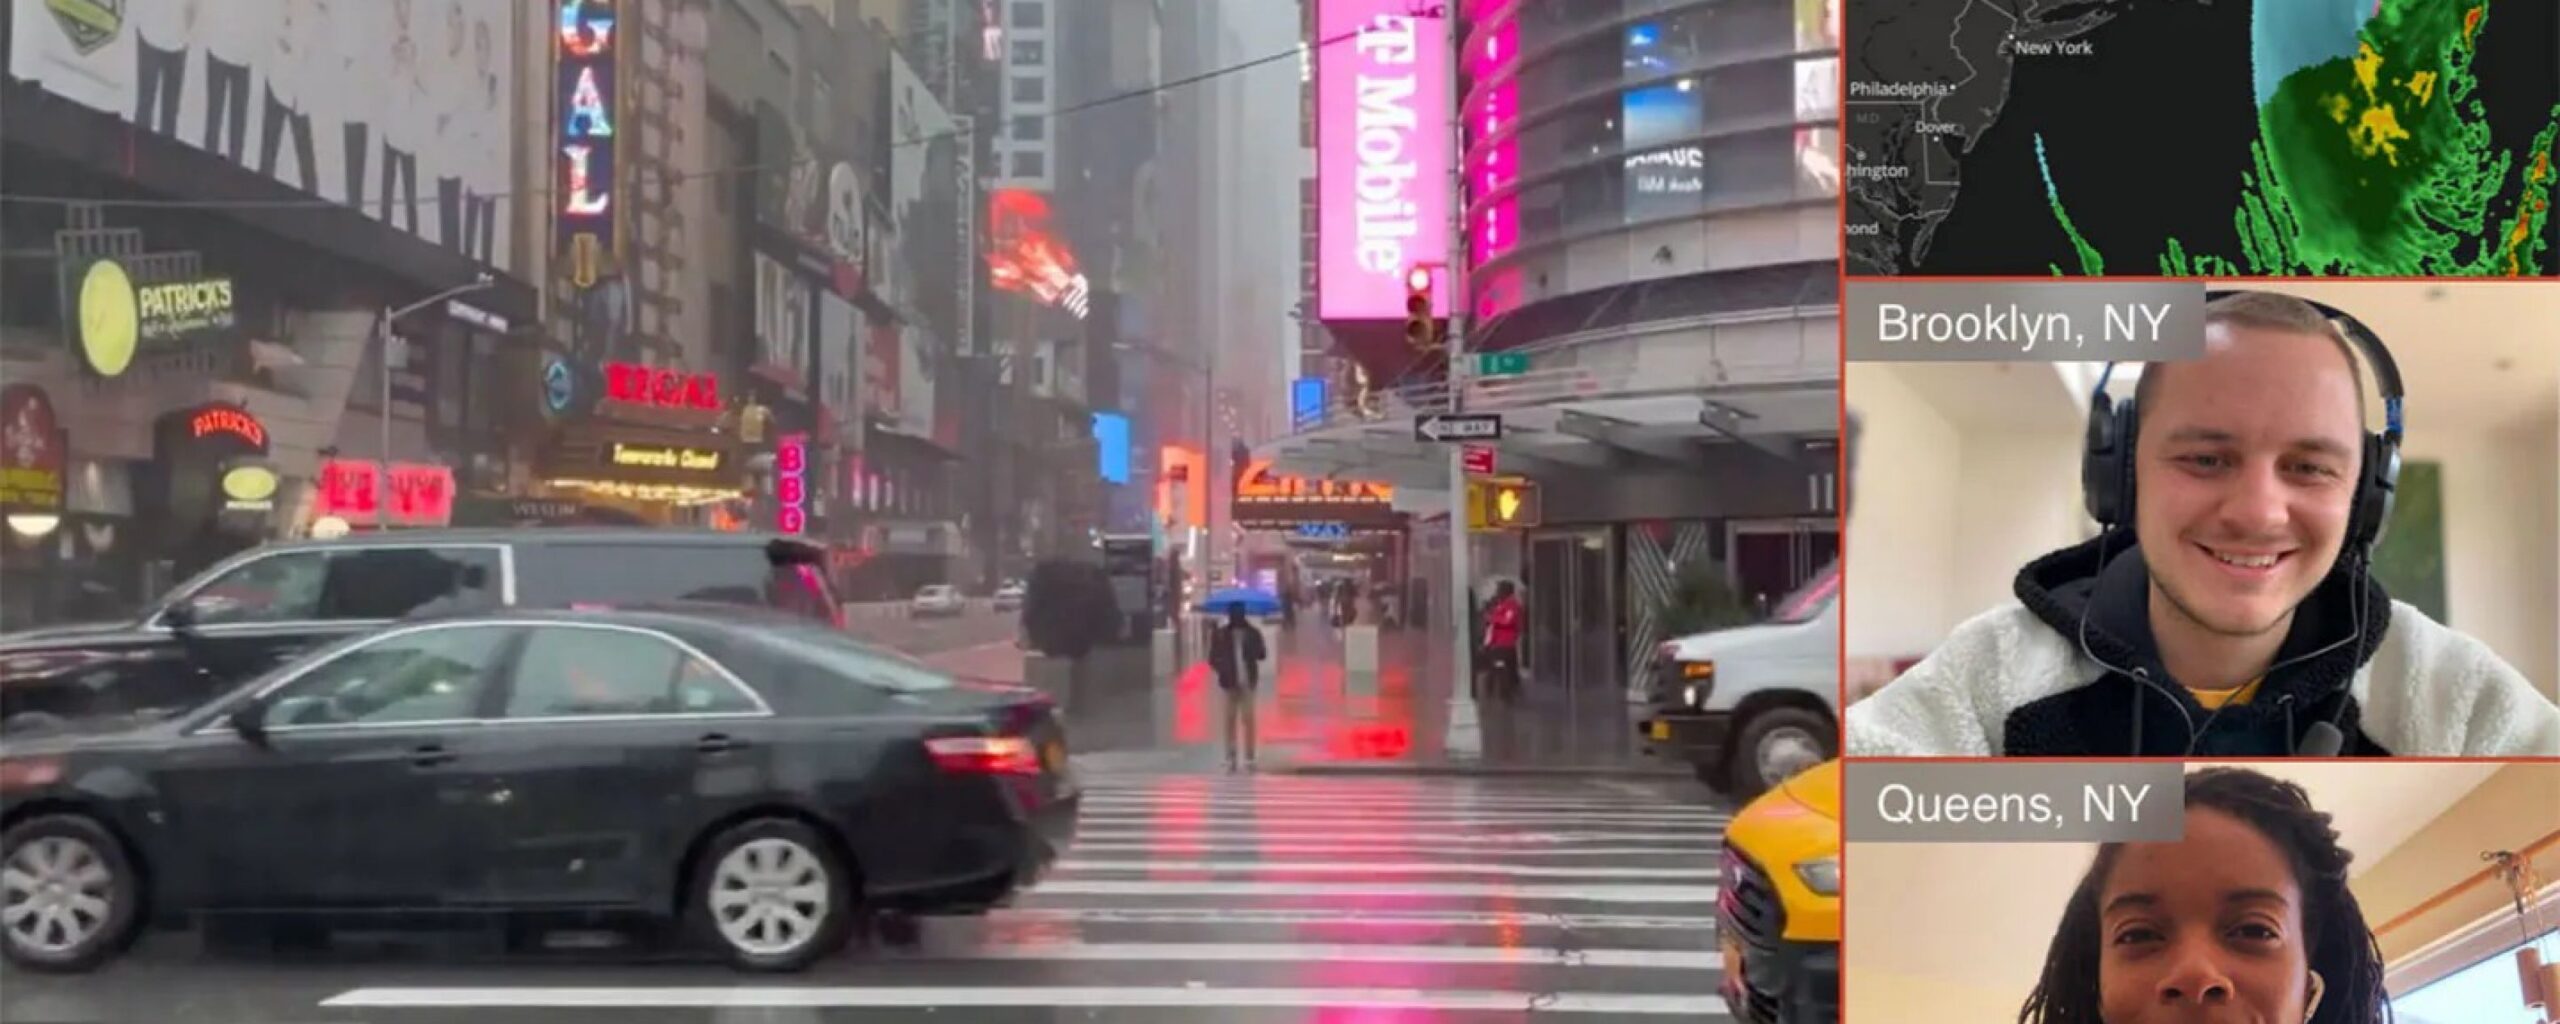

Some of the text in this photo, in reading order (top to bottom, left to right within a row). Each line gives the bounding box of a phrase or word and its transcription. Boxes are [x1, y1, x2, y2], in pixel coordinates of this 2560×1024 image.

[2015, 41, 2093, 55] New York
[1850, 80, 1948, 97] Philadelphia
[1915, 121, 1954, 134] Dover
[1356, 73, 1417, 278] Mobile
